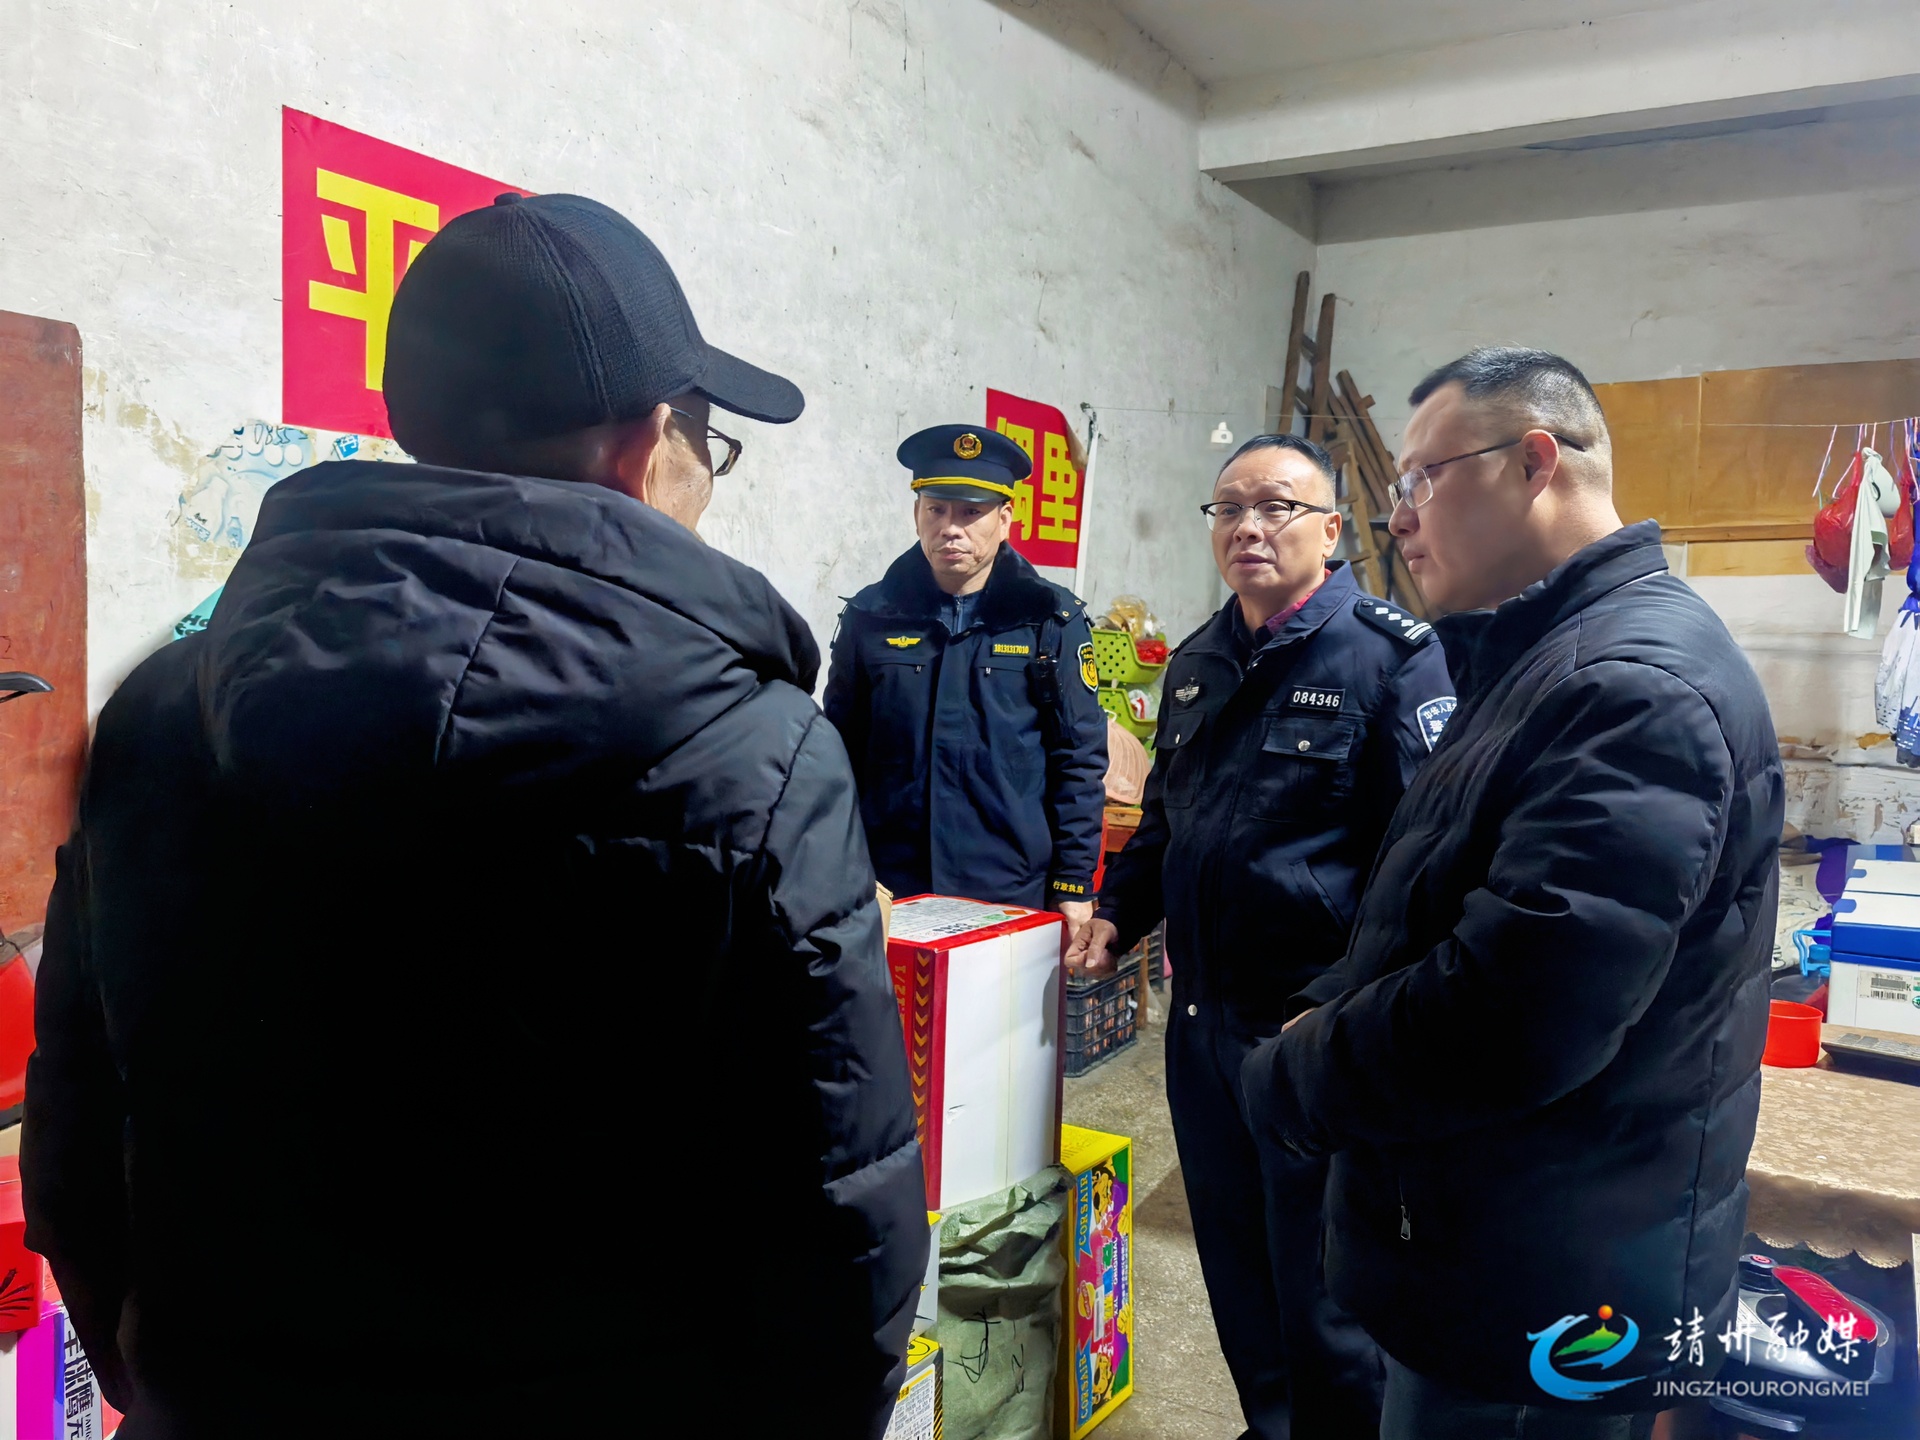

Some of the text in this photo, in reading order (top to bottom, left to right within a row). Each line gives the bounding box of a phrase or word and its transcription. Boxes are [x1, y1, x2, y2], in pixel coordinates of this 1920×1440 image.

[309, 168, 439, 391] 平
[1293, 691, 1340, 707] 084346
[1079, 1174, 1089, 1246] CORSAIR
[1079, 1354, 1089, 1419] CORSAIR
